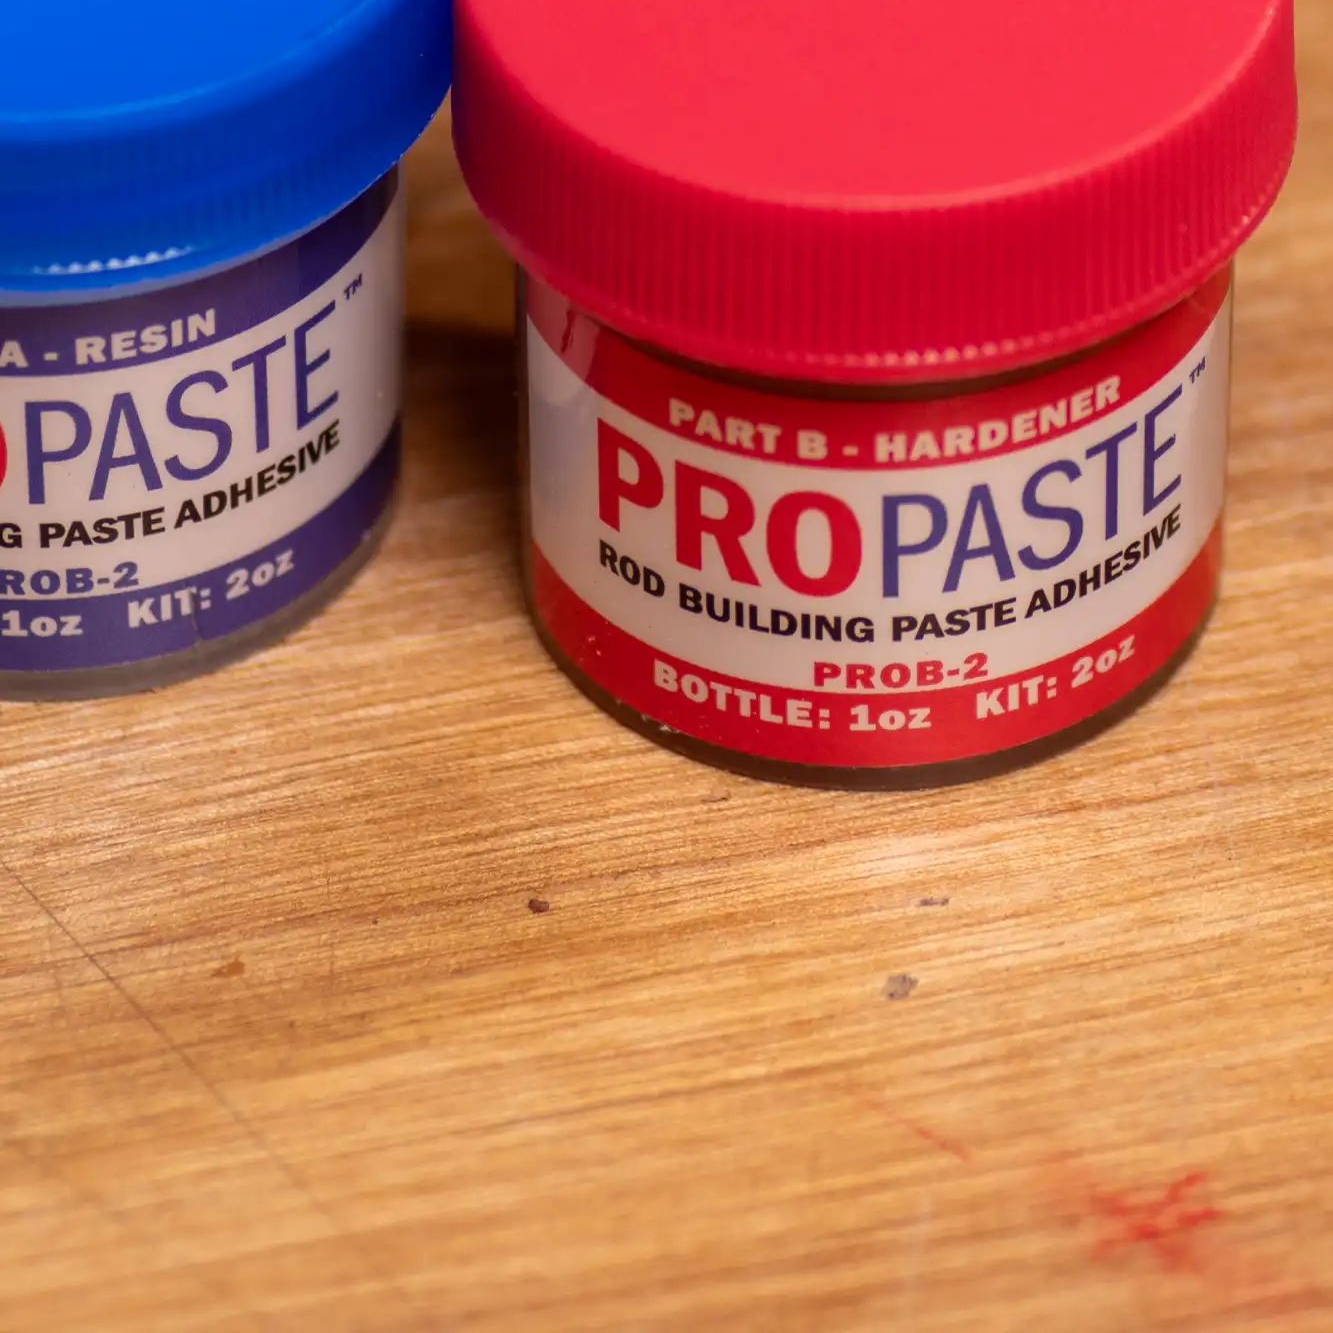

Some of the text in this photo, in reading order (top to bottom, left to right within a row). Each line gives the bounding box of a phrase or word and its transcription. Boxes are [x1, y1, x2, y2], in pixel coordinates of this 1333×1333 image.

[75, 308, 216, 365] RESIN
[670, 398, 781, 454] PART
[797, 429, 828, 459] B
[876, 376, 1121, 463] HARDENER
[39, 507, 165, 549] PASTE
[174, 419, 340, 529] ADHESIVE
[226, 549, 294, 600] 2oz
[600, 505, 1181, 642] ROD BUILDING PASTE ADHESIVE
[653, 659, 830, 729] BOTTLE:
[976, 674, 1057, 719] KIT:
[1072, 636, 1136, 685] 2oz
[813, 653, 988, 687] PROB-2
